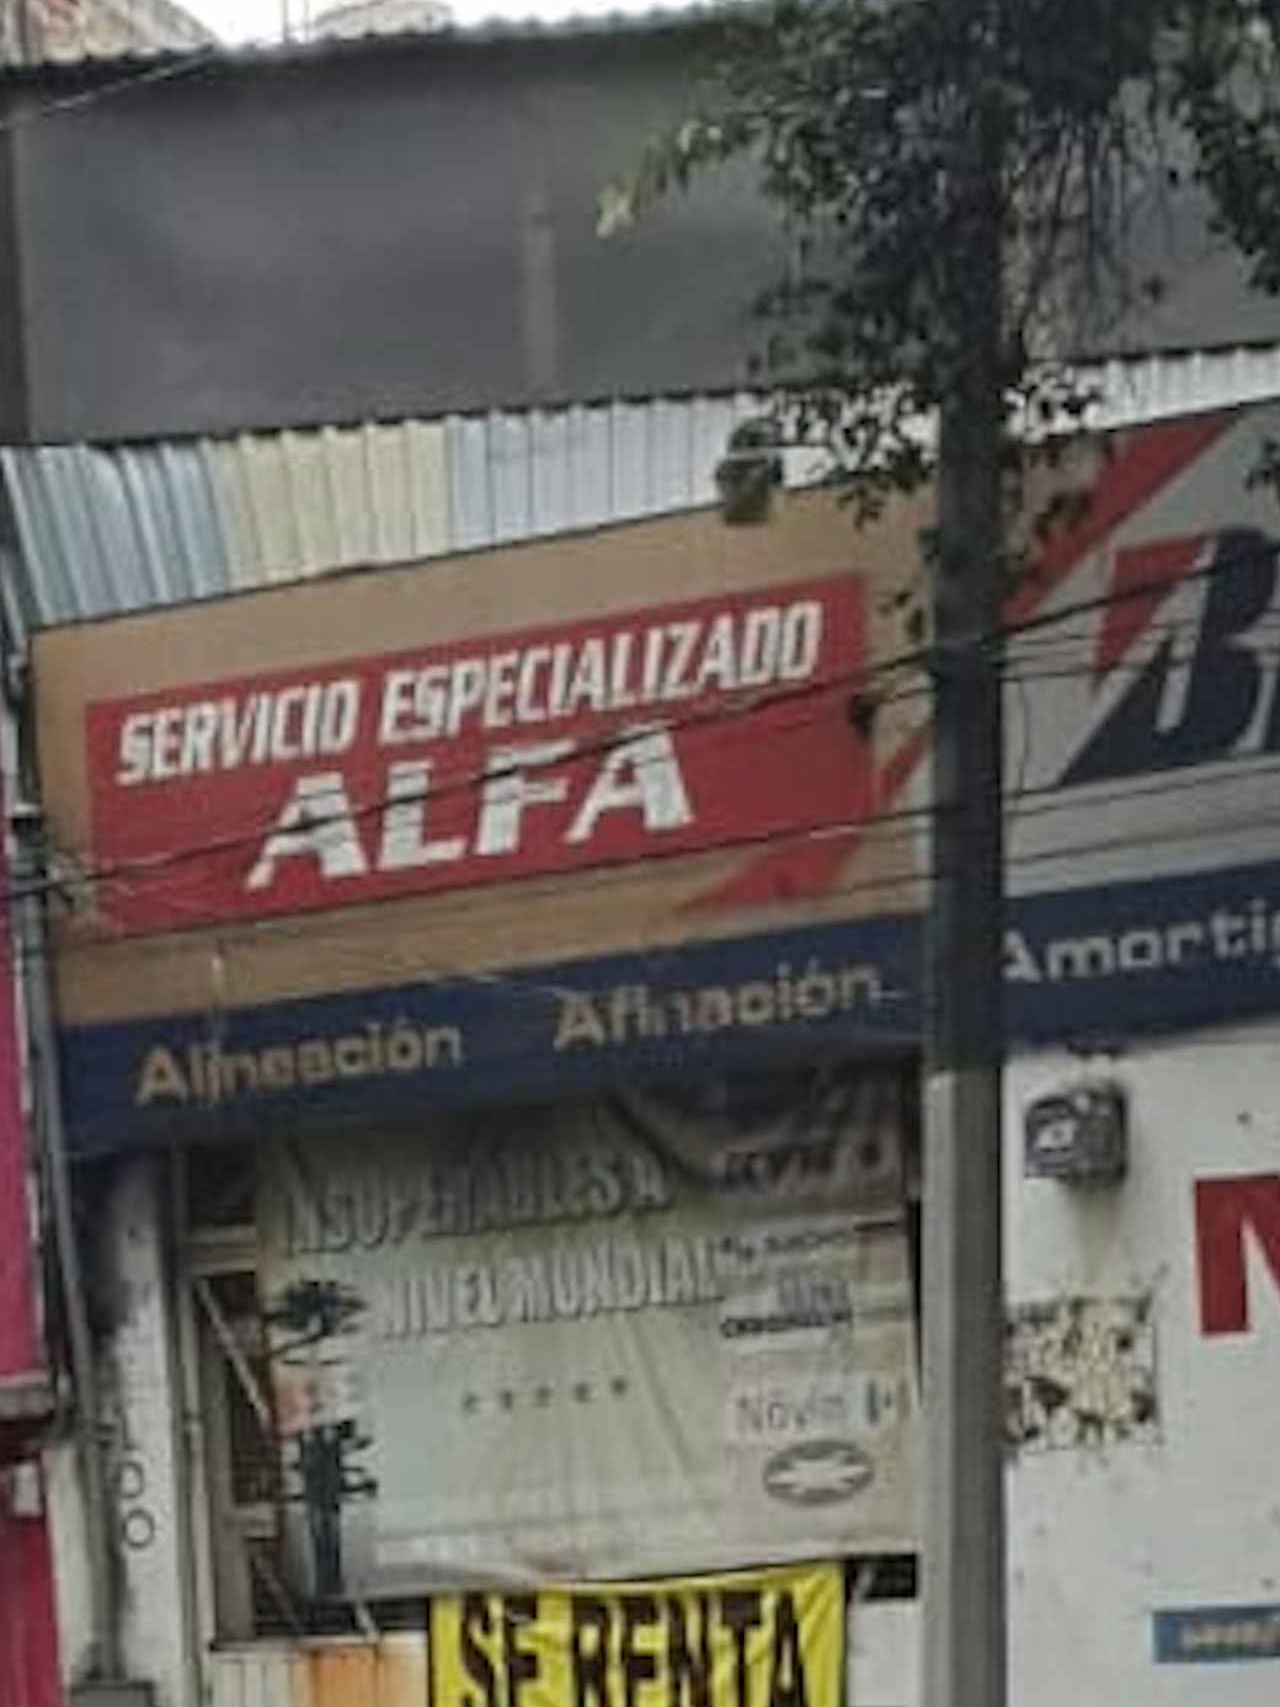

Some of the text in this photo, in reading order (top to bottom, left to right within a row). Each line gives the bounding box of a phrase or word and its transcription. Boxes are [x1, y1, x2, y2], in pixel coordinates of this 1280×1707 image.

[117, 599, 824, 786] SERVICIO ESPECIALIZADO
[244, 721, 695, 891] ALFA
[131, 1013, 464, 1107] Alineación
[552, 955, 885, 1054] Afinación
